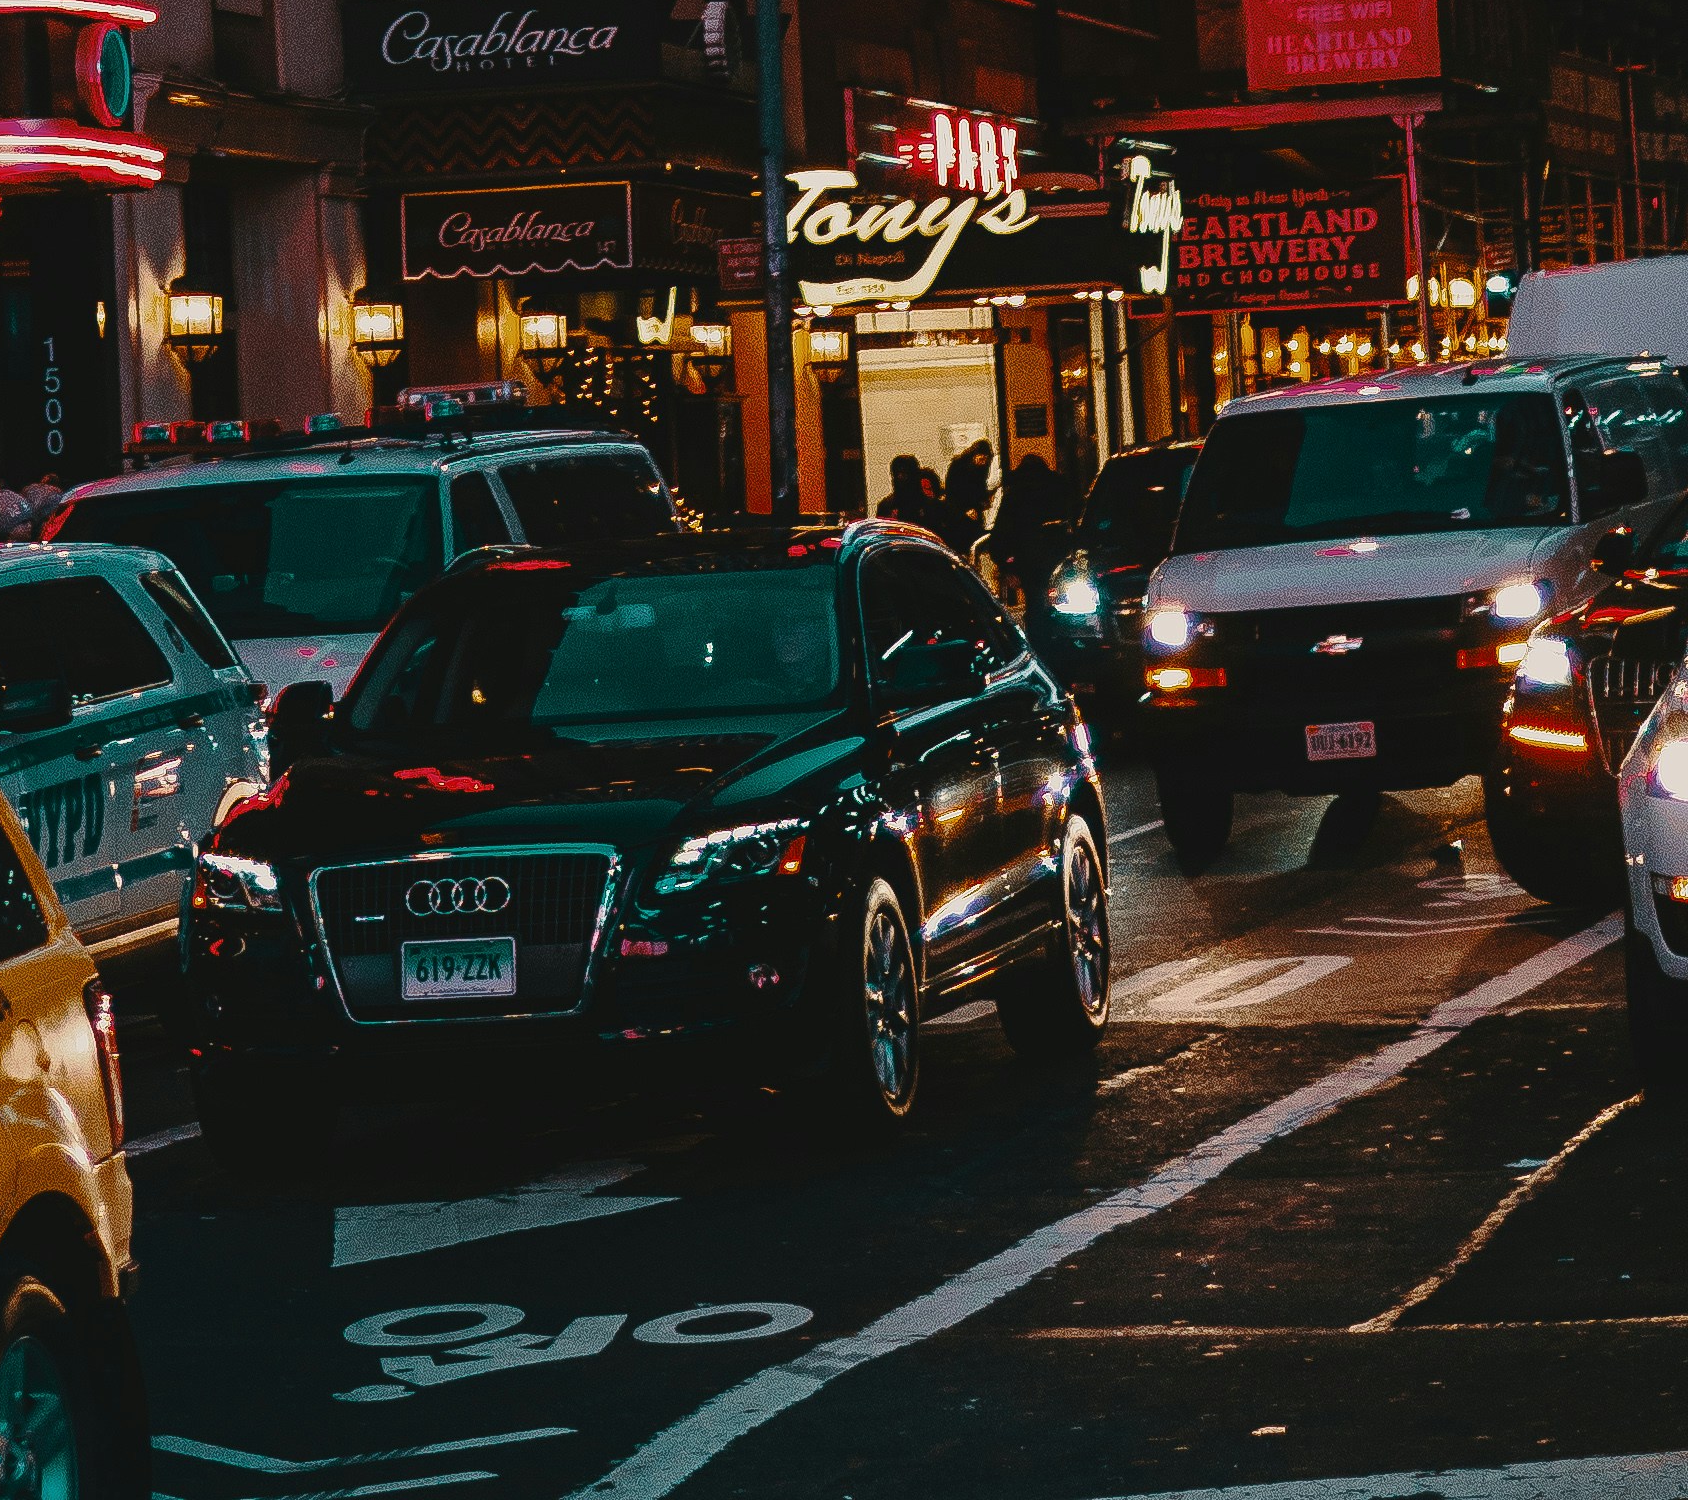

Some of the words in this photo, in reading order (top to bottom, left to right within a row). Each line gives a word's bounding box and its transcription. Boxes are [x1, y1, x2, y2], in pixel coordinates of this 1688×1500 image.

[1295, 3, 1345, 23] FREE
[382, 9, 619, 72] Casablanca
[1266, 26, 1413, 55] HEARTLAND
[1285, 48, 1403, 75] BREWERY
[933, 112, 1018, 194] PARK
[438, 211, 596, 253] Casablanca
[785, 169, 1040, 306] Tony's
[1173, 207, 1379, 242] EARTLAND
[1178, 235, 1357, 269] BREWERY
[1176, 272, 1211, 288] ND
[1221, 262, 1381, 285] CHOPHOUSE
[42, 337, 65, 456] 1500
